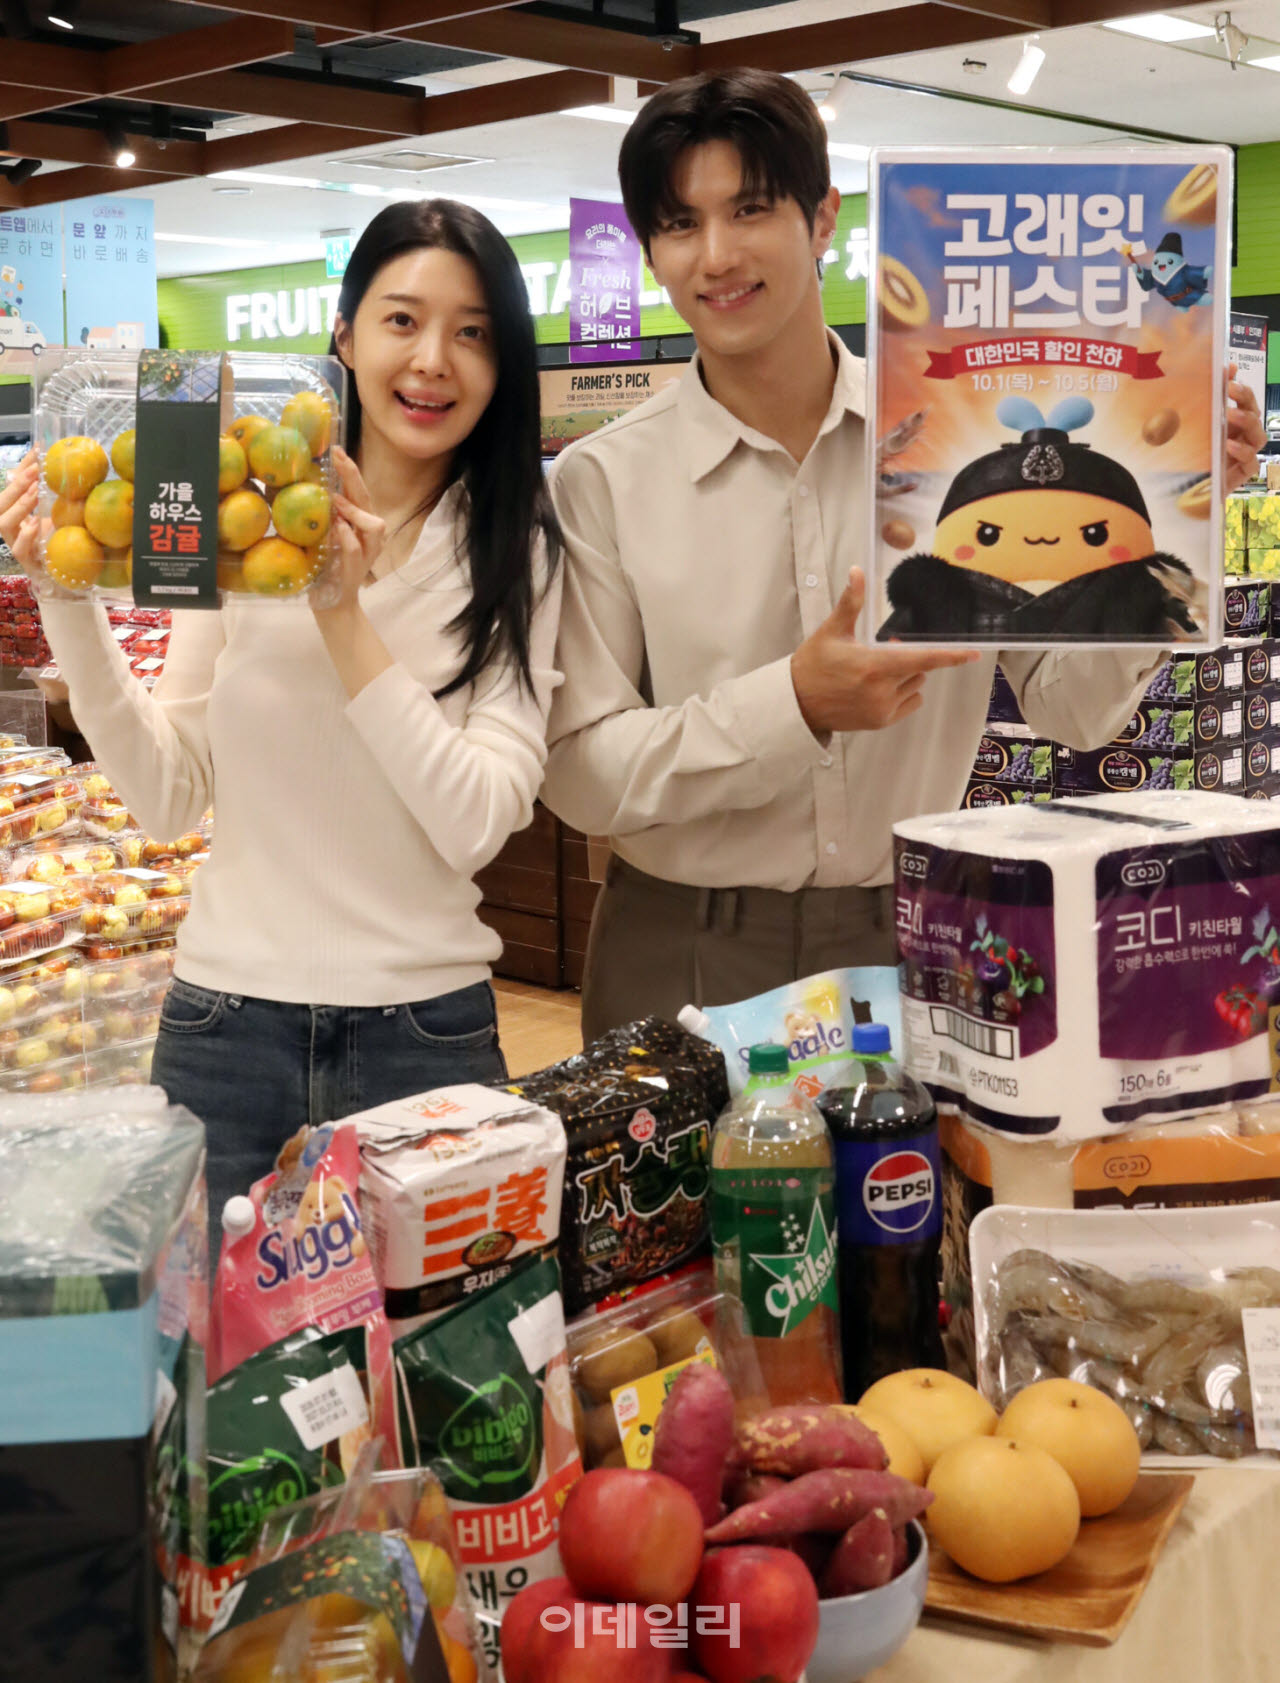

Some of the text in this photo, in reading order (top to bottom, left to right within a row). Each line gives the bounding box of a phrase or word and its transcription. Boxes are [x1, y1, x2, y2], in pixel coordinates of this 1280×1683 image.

[944, 194, 1147, 257] 고래잇
[580, 266, 631, 290] Fresh
[943, 266, 1150, 328] 페스타
[965, 341, 1123, 368] 대한민국 할인 천하
[571, 372, 650, 391] FARMER'S PICK
[971, 373, 1033, 391] 10.1(목)
[158, 482, 194, 501] 가을
[149, 502, 202, 521] 하우스
[149, 524, 202, 553] 감귤
[1115, 905, 1242, 952] 코디 키친타월
[868, 1177, 931, 1202] PEPSI
[422, 1166, 548, 1276] 三養
[456, 1497, 552, 1556] 비비고
